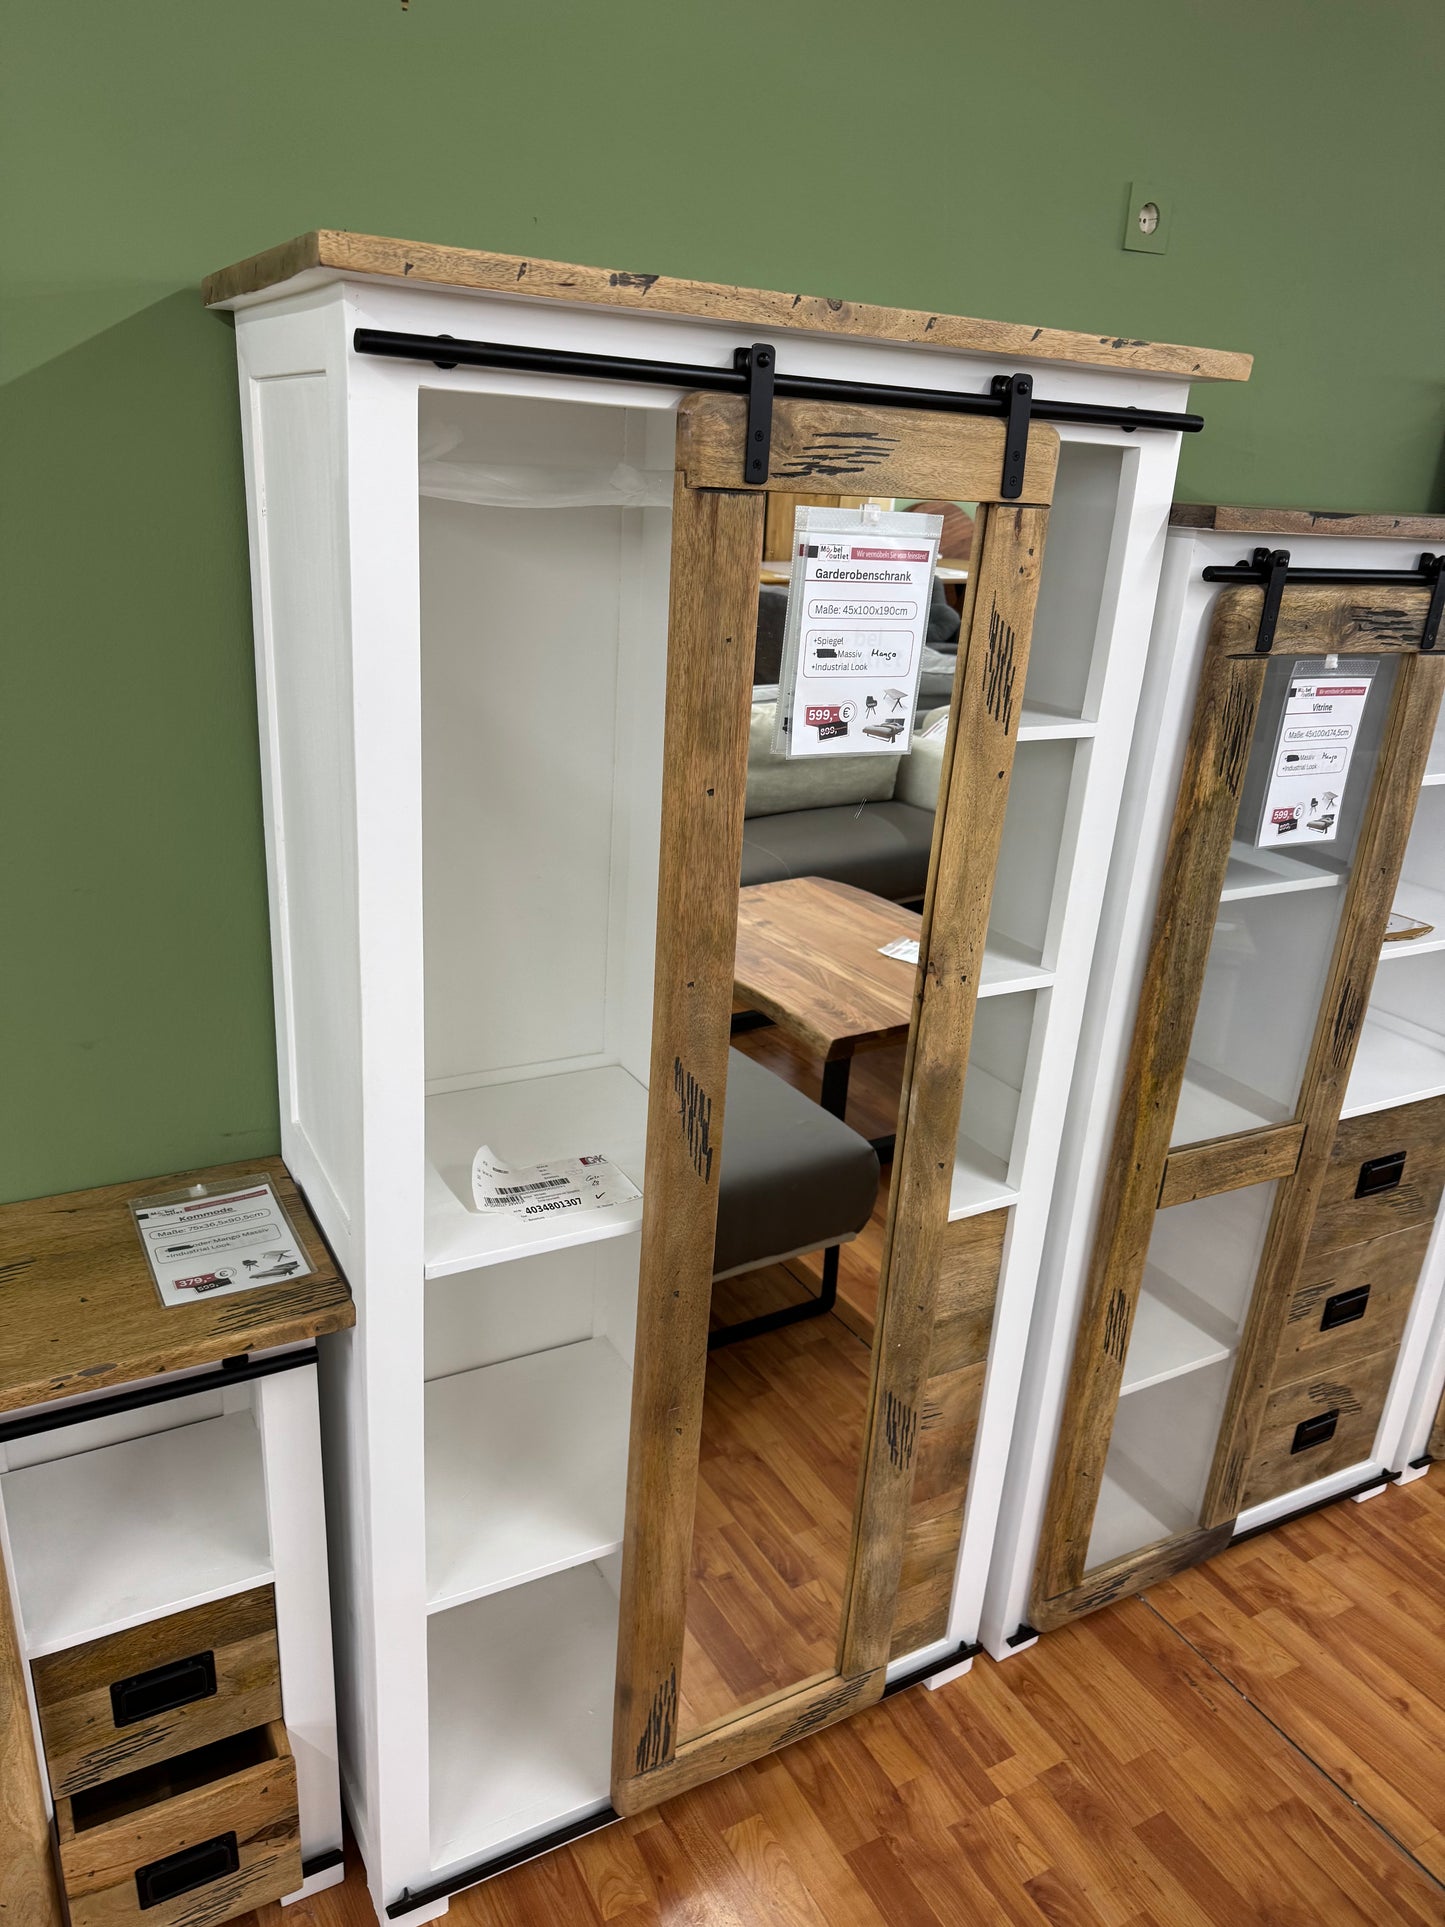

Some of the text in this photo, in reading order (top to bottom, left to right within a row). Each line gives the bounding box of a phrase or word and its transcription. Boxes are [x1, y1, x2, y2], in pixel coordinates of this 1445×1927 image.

[815, 568, 912, 582] Garderobenschrank
[815, 604, 908, 616] Maße: 45x100x190cm
[837, 649, 862, 658] Massiv
[850, 663, 868, 671] Look
[1312, 702, 1333, 712] Vitrine
[525, 1197, 582, 1215] 4034801307
[179, 1206, 234, 1221] Kommode
[157, 1228, 186, 1238] Maße:
